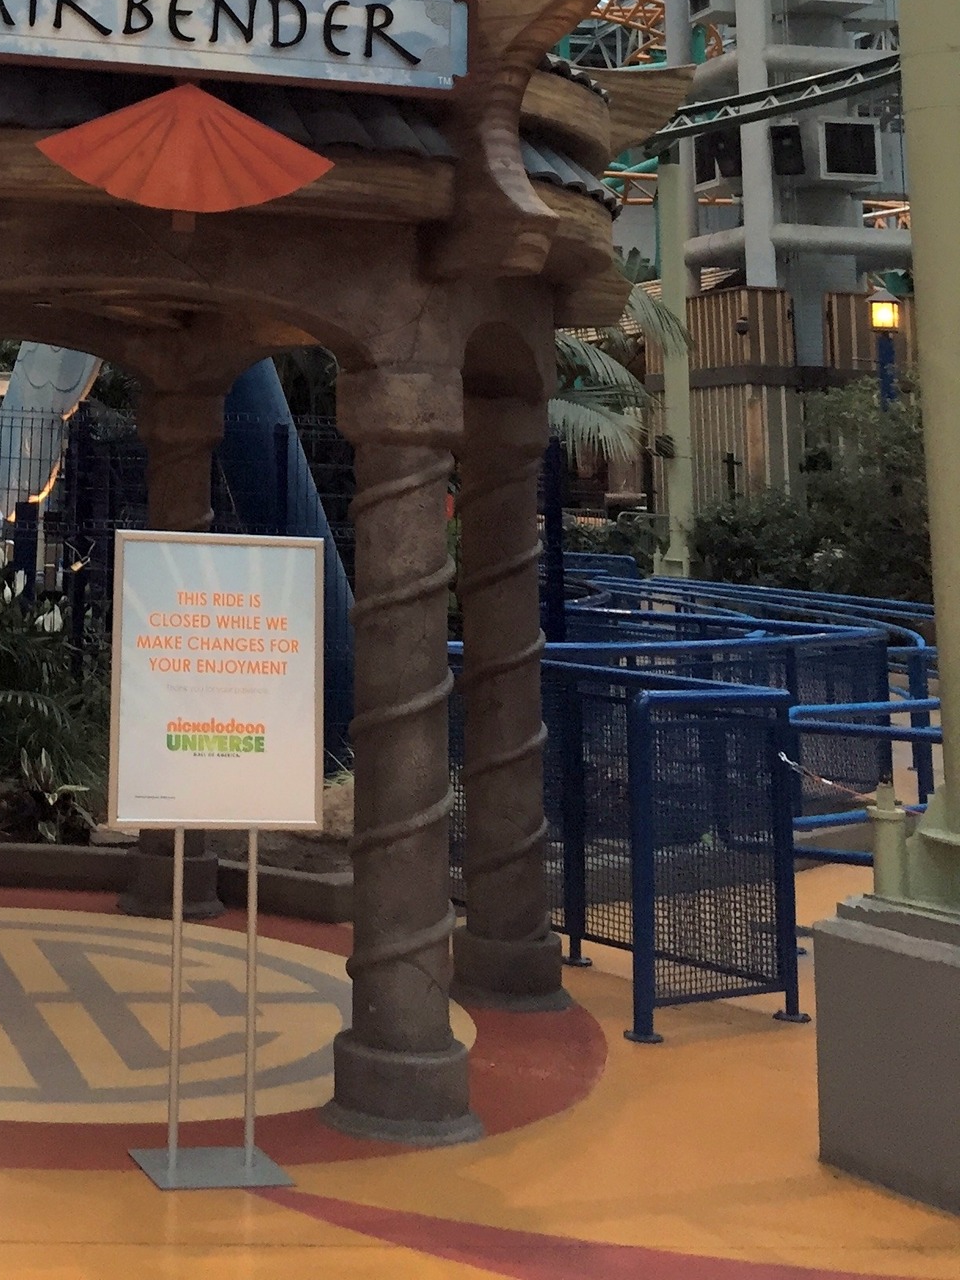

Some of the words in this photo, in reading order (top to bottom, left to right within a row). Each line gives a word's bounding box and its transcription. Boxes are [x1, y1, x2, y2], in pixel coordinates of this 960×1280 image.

[437, 76, 452, 85] TM
[177, 591, 207, 607] THIS
[213, 592, 244, 608] RIDE
[249, 593, 261, 608] IS
[149, 612, 211, 629] CLOSED
[216, 614, 260, 630] WHILE
[266, 616, 288, 631] WE
[136, 634, 183, 650] MAKE
[187, 636, 265, 652] CHANGES
[270, 638, 299, 654] FOR
[149, 657, 191, 673] YOUR
[197, 658, 288, 675] ENJOYMENT
[166, 716, 266, 734] nickelodeon
[166, 733, 265, 753] UNIVERSE
